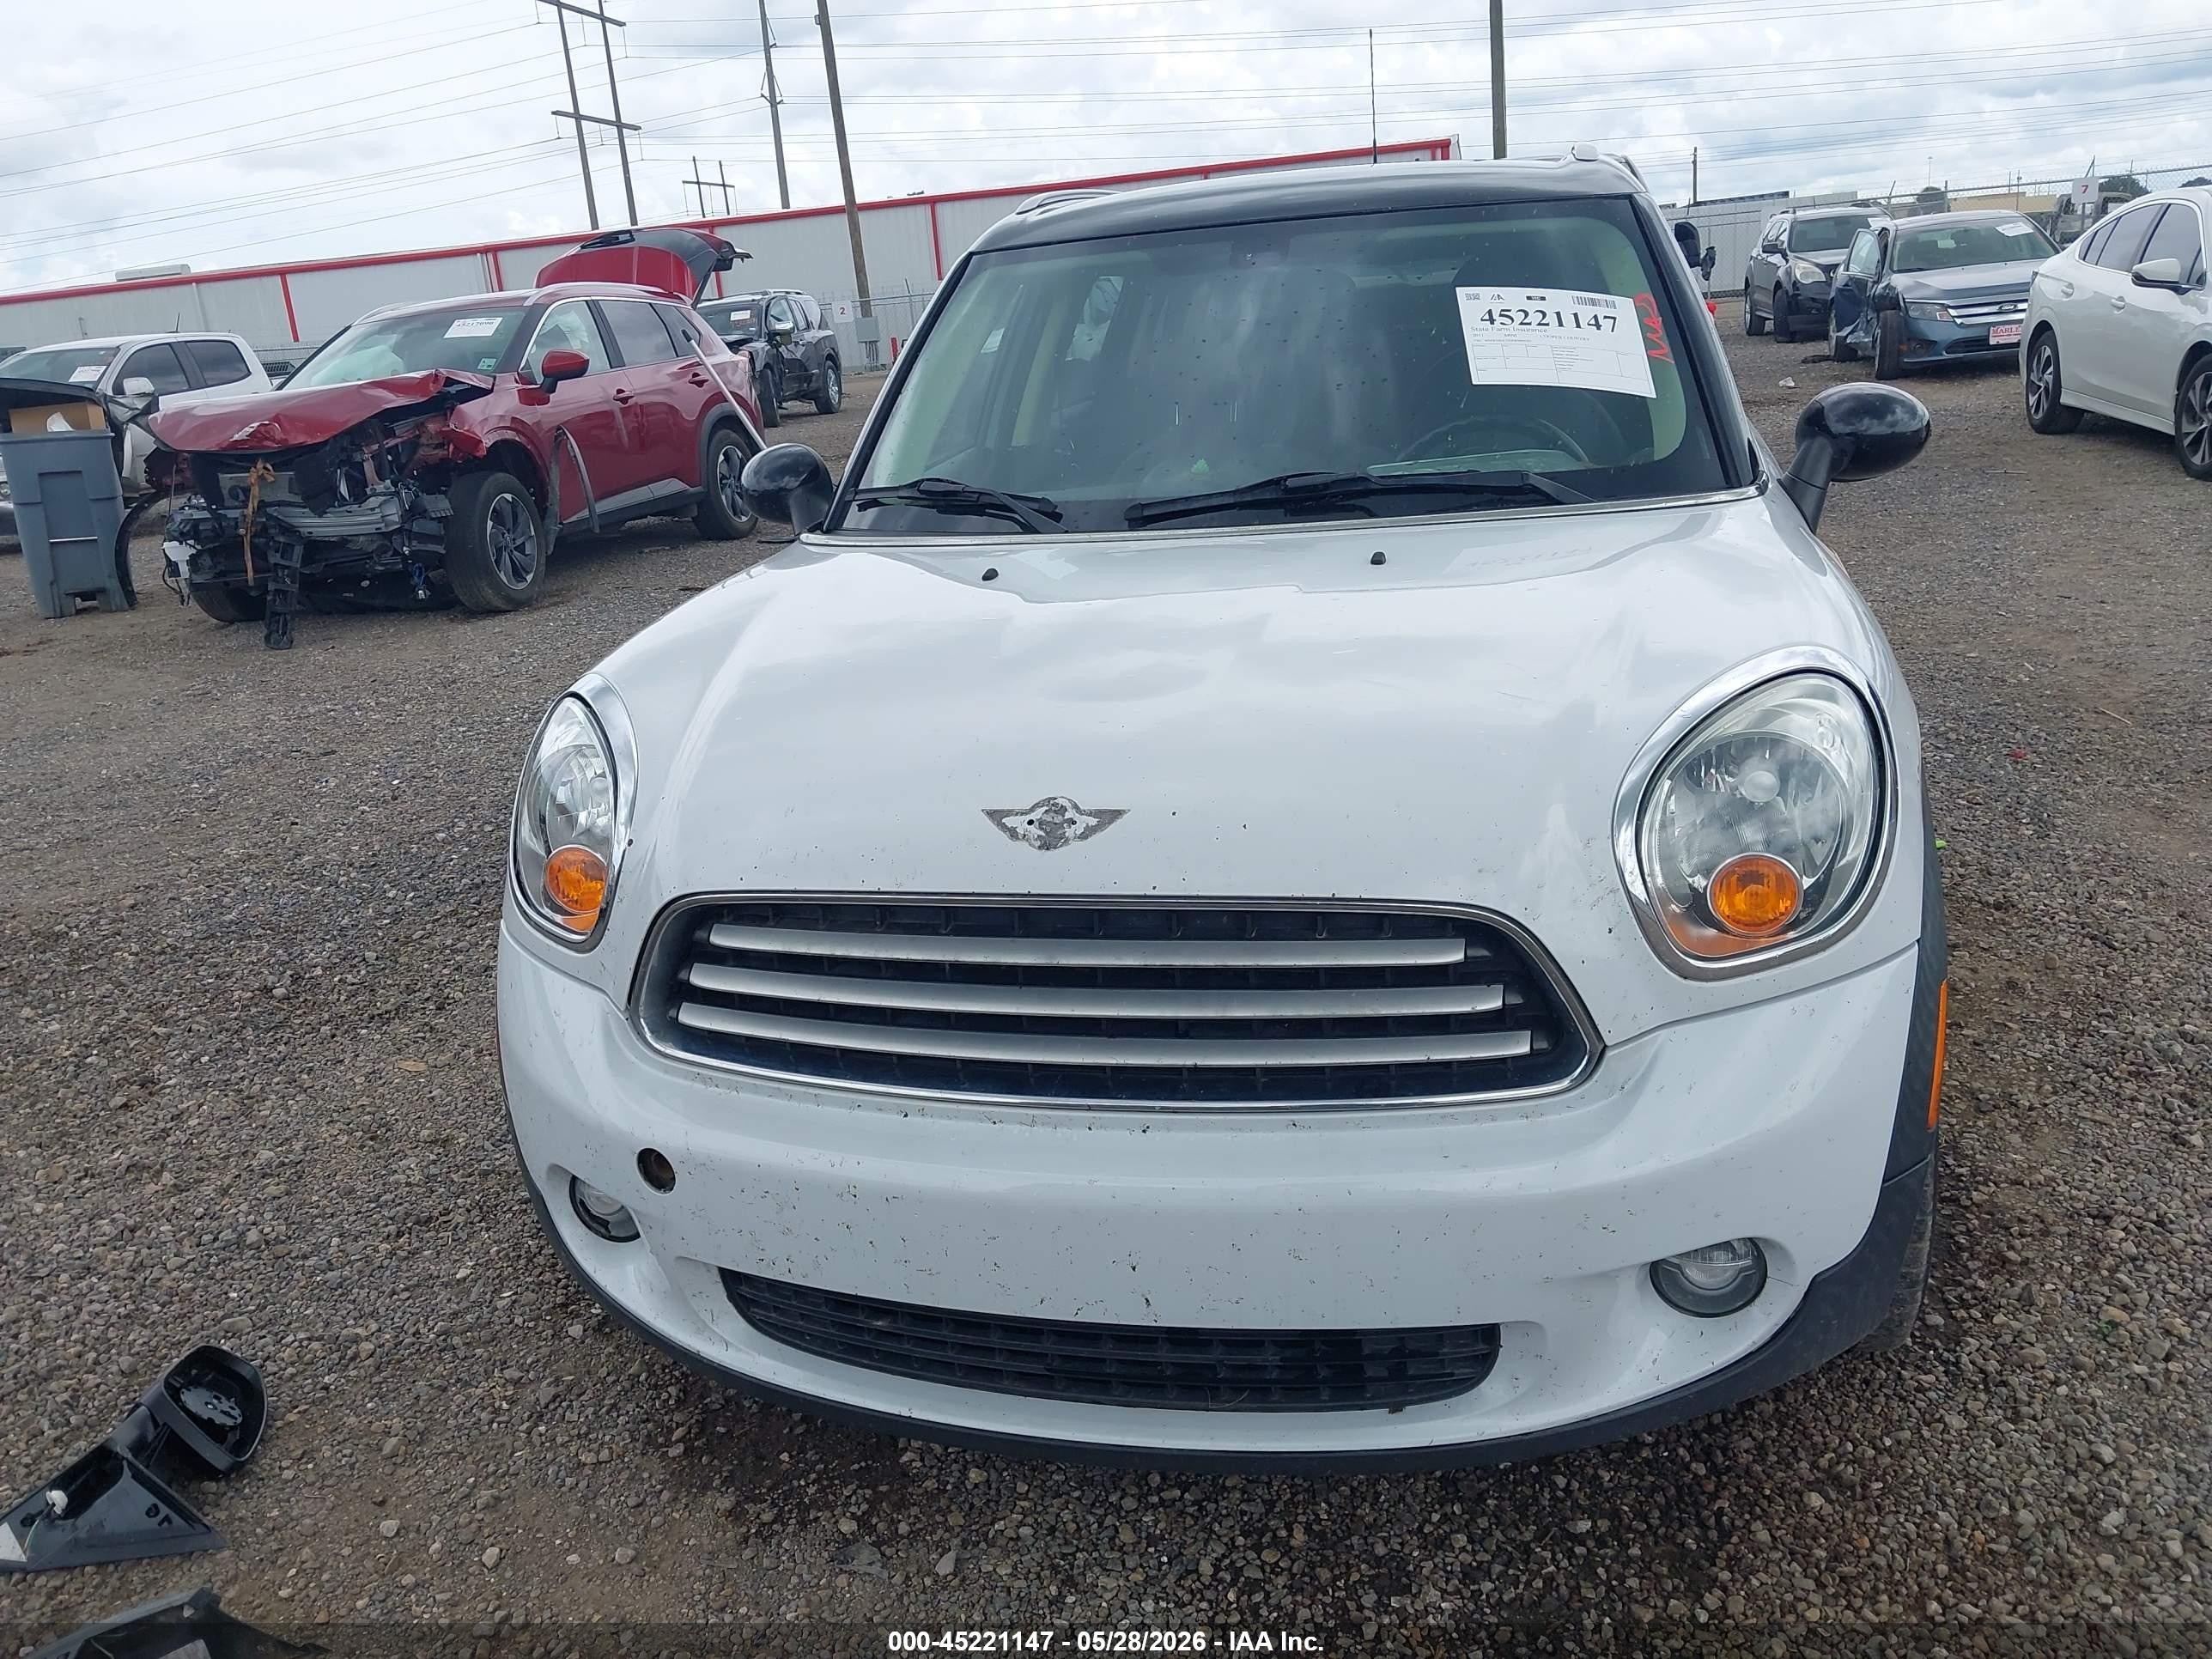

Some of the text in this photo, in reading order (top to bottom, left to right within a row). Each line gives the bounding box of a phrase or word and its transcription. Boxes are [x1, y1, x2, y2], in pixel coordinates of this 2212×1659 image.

[2081, 185, 2089, 194] 7
[839, 307, 846, 315] 2
[1480, 308, 1617, 332] 45221147
